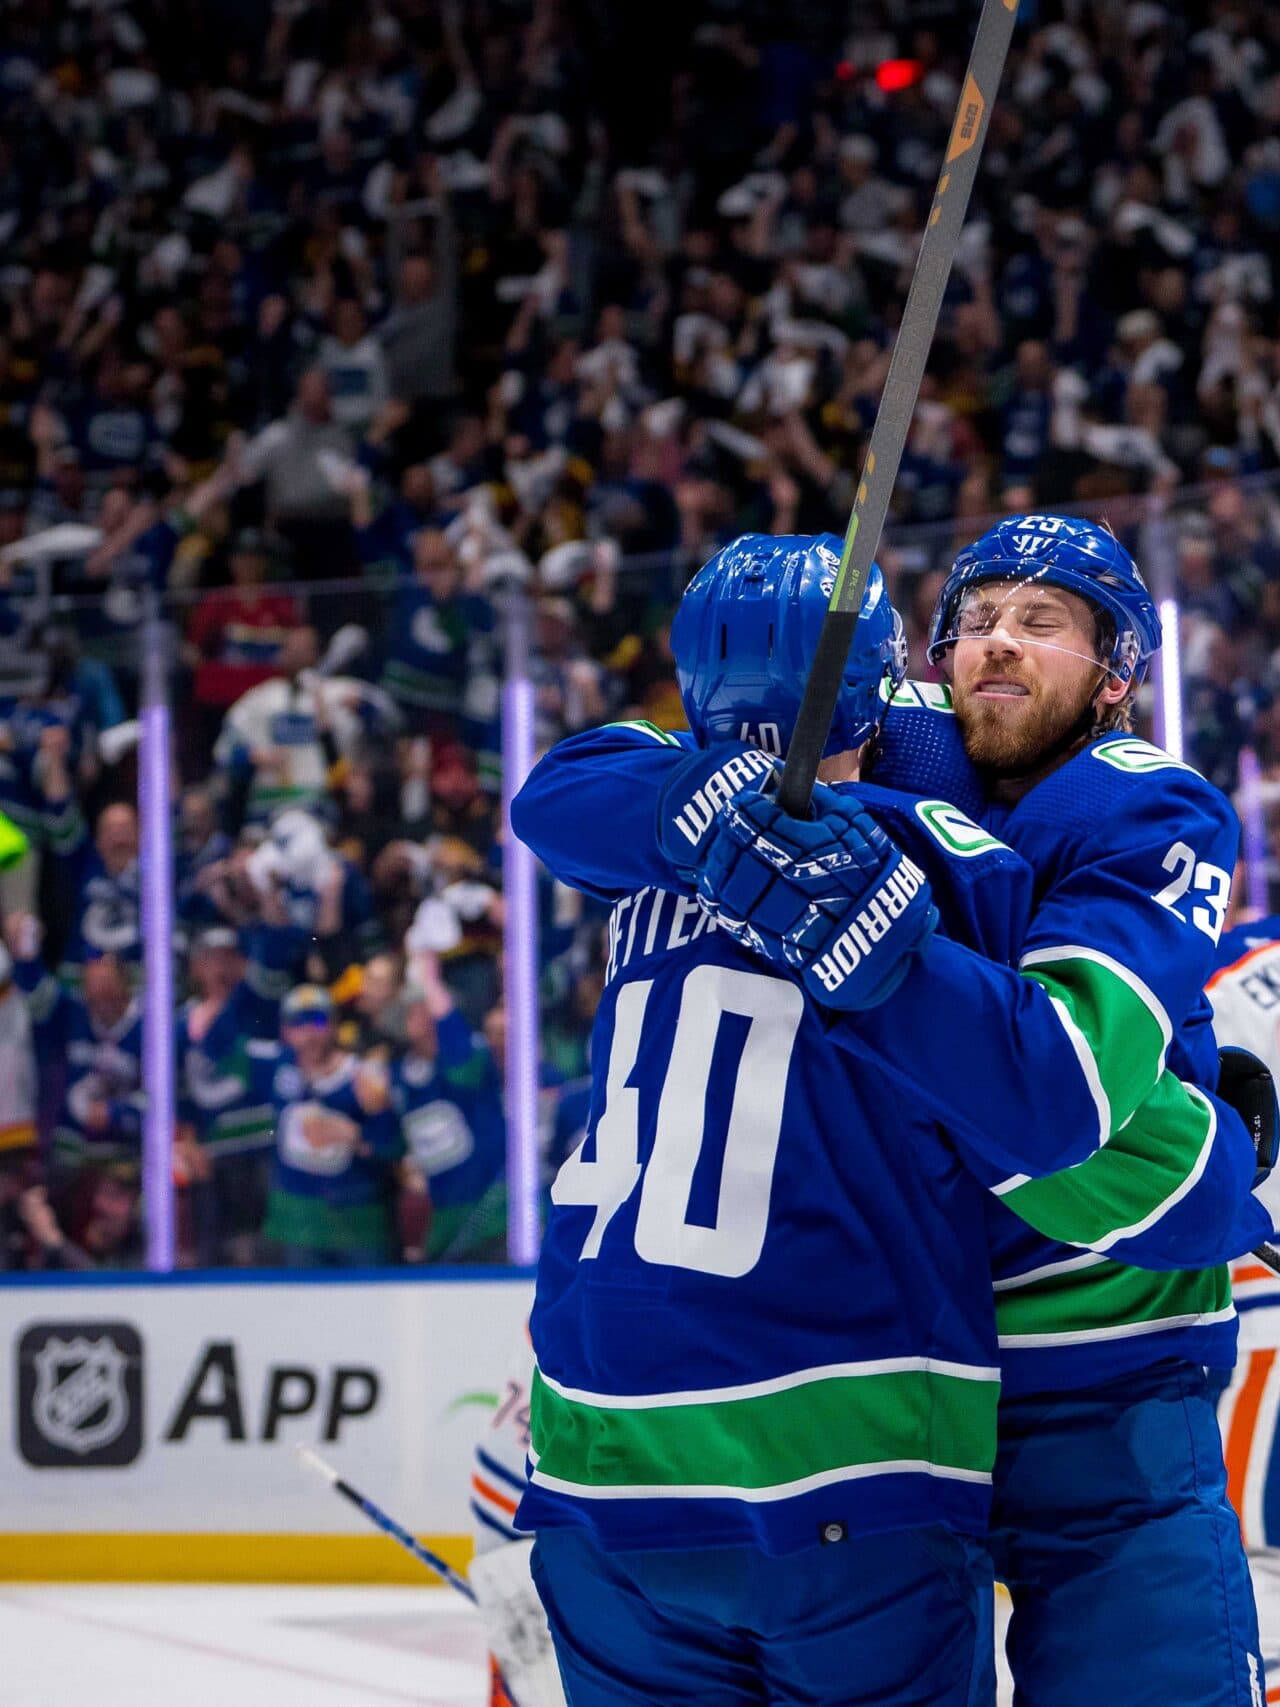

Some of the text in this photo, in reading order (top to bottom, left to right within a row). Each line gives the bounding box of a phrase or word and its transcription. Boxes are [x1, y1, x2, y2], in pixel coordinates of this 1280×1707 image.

[811, 854, 926, 992] WARRIOR
[1150, 841, 1231, 948] 23
[551, 964, 805, 1278] 40
